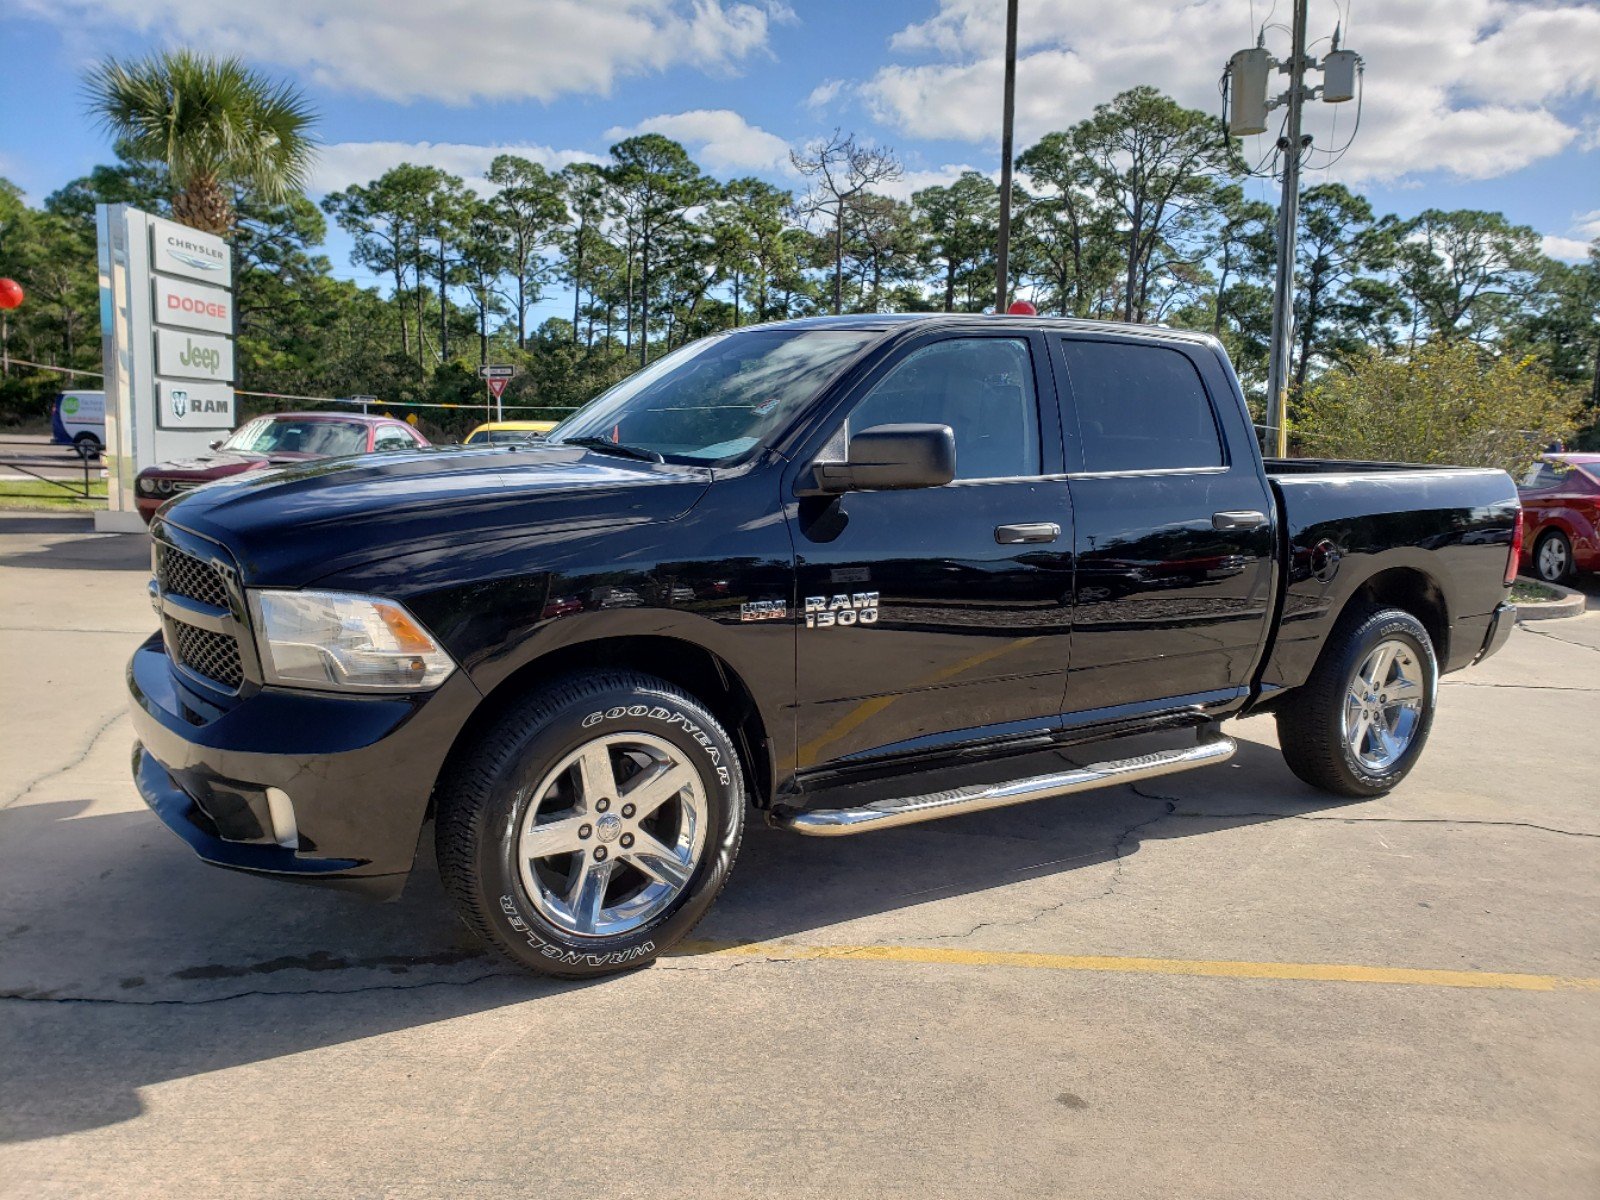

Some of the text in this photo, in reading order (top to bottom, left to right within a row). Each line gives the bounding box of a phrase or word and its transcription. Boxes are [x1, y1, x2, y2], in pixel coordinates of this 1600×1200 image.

[167, 236, 224, 259] CHRYSLER
[167, 293, 227, 319] DODGE
[179, 338, 220, 375] Jeep
[190, 399, 228, 413] RAM
[805, 591, 880, 612] RAM
[805, 607, 879, 629] 1500
[581, 705, 731, 786] GOODYEAR
[499, 894, 656, 967] WRANGLER
